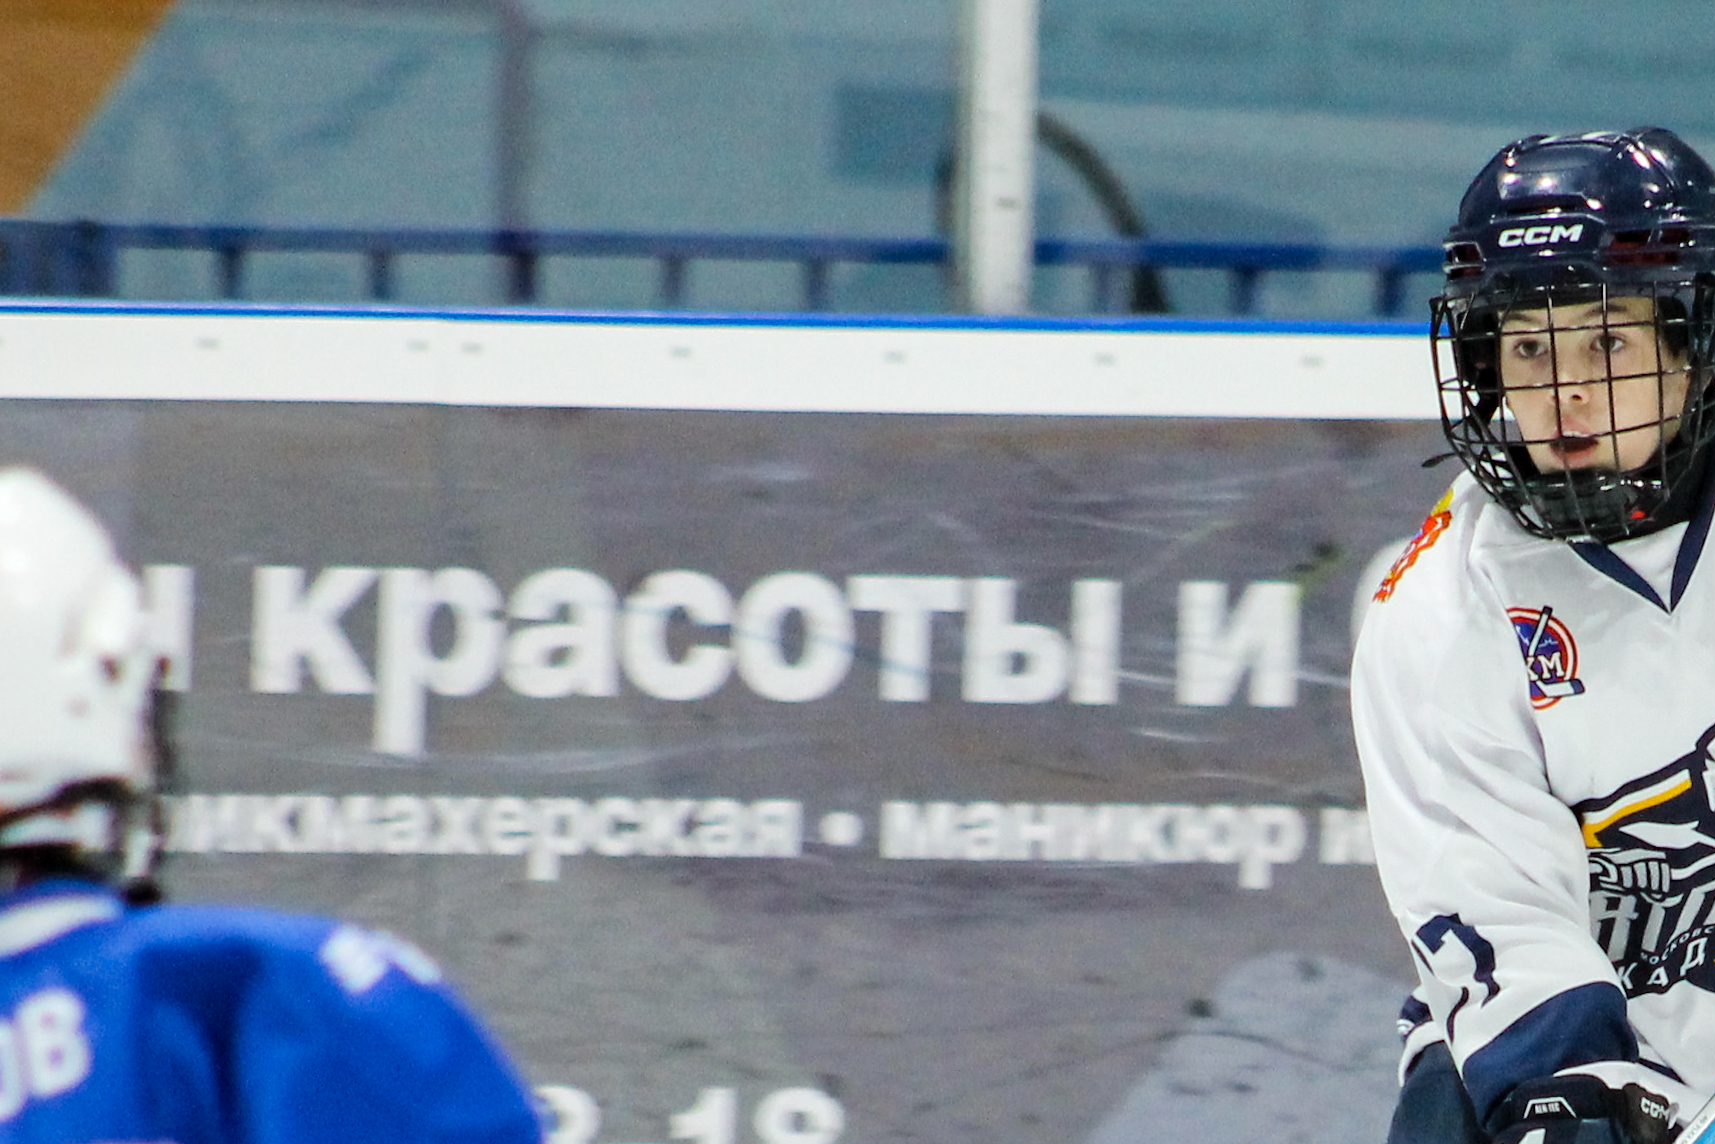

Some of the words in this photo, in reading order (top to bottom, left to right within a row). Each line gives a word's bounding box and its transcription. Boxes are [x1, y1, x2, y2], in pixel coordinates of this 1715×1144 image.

[1498, 224, 1584, 248] CCM
[250, 565, 1122, 755] красоты
[1176, 580, 1300, 707] и
[164, 794, 800, 882] икмахерская
[878, 800, 1307, 890] маникюр
